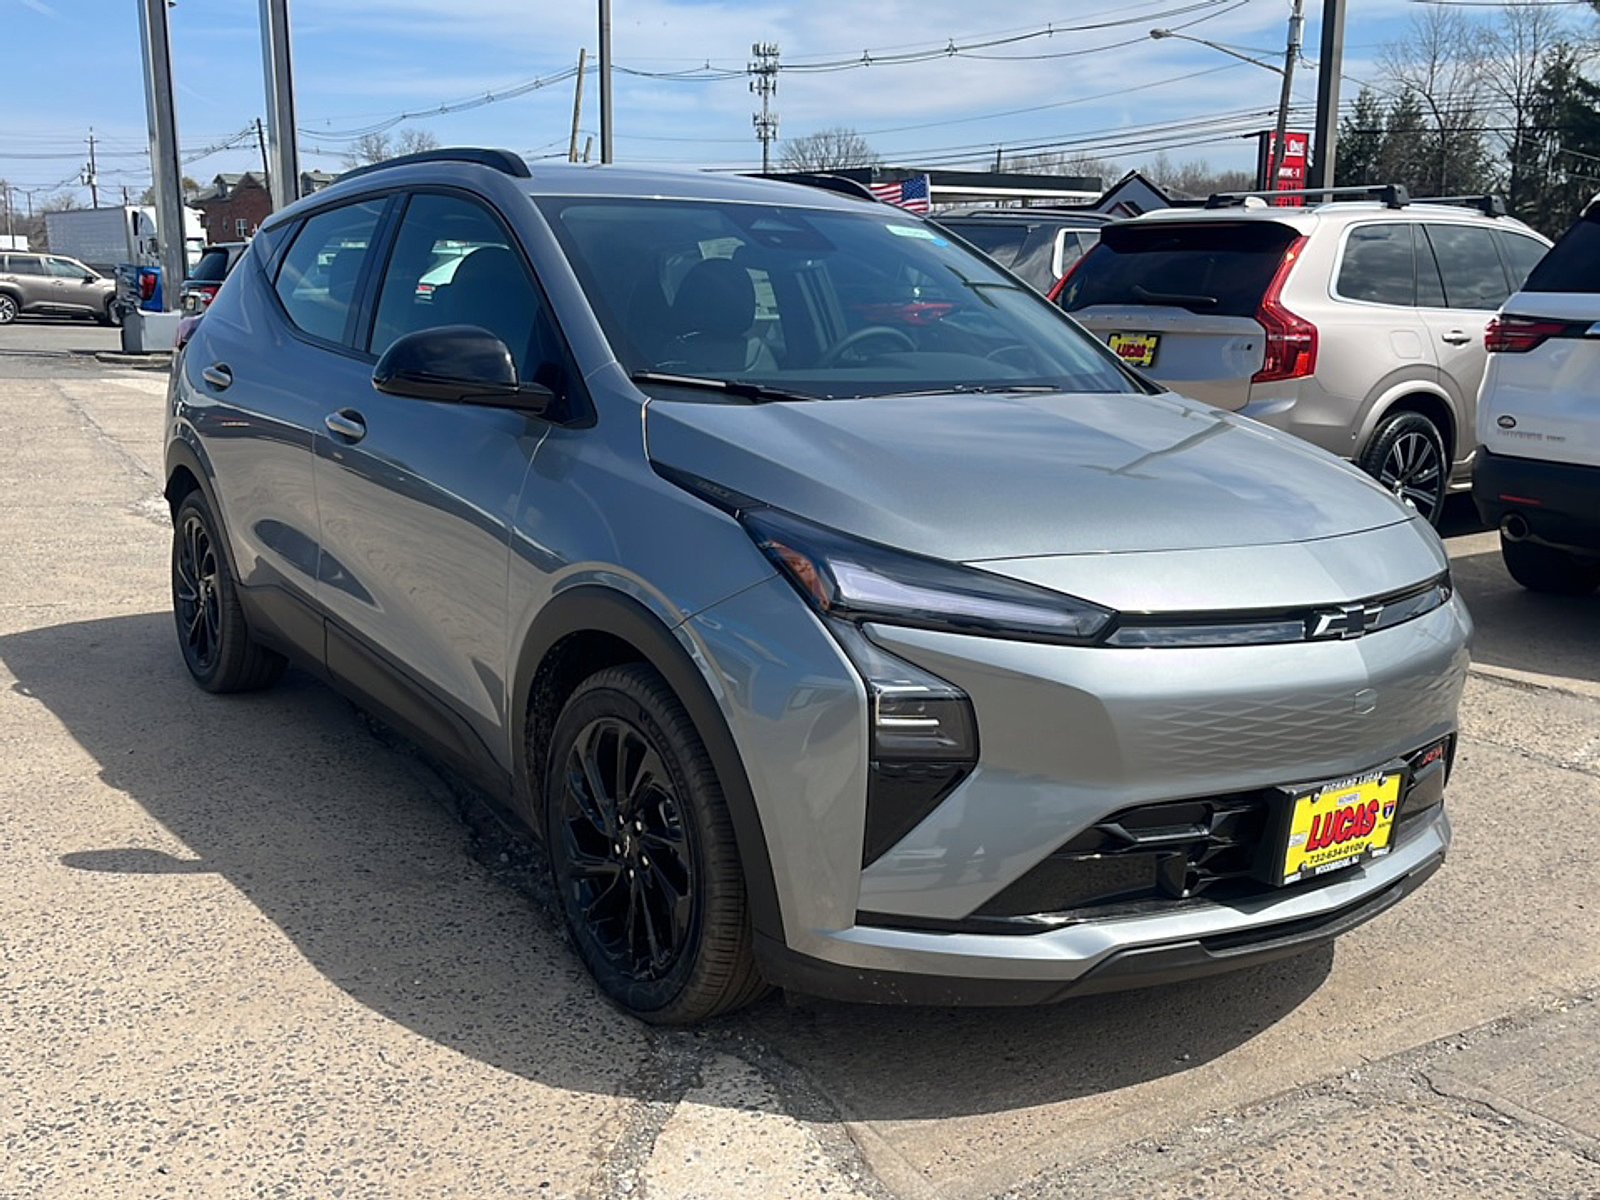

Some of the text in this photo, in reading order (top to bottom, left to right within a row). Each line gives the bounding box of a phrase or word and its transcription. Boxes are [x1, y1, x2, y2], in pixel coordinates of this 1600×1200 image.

[1322, 772, 1382, 793] RICHARD LUCAS
[1305, 799, 1379, 852] LUCAS
[1310, 842, 1364, 863] 732-634-0100
